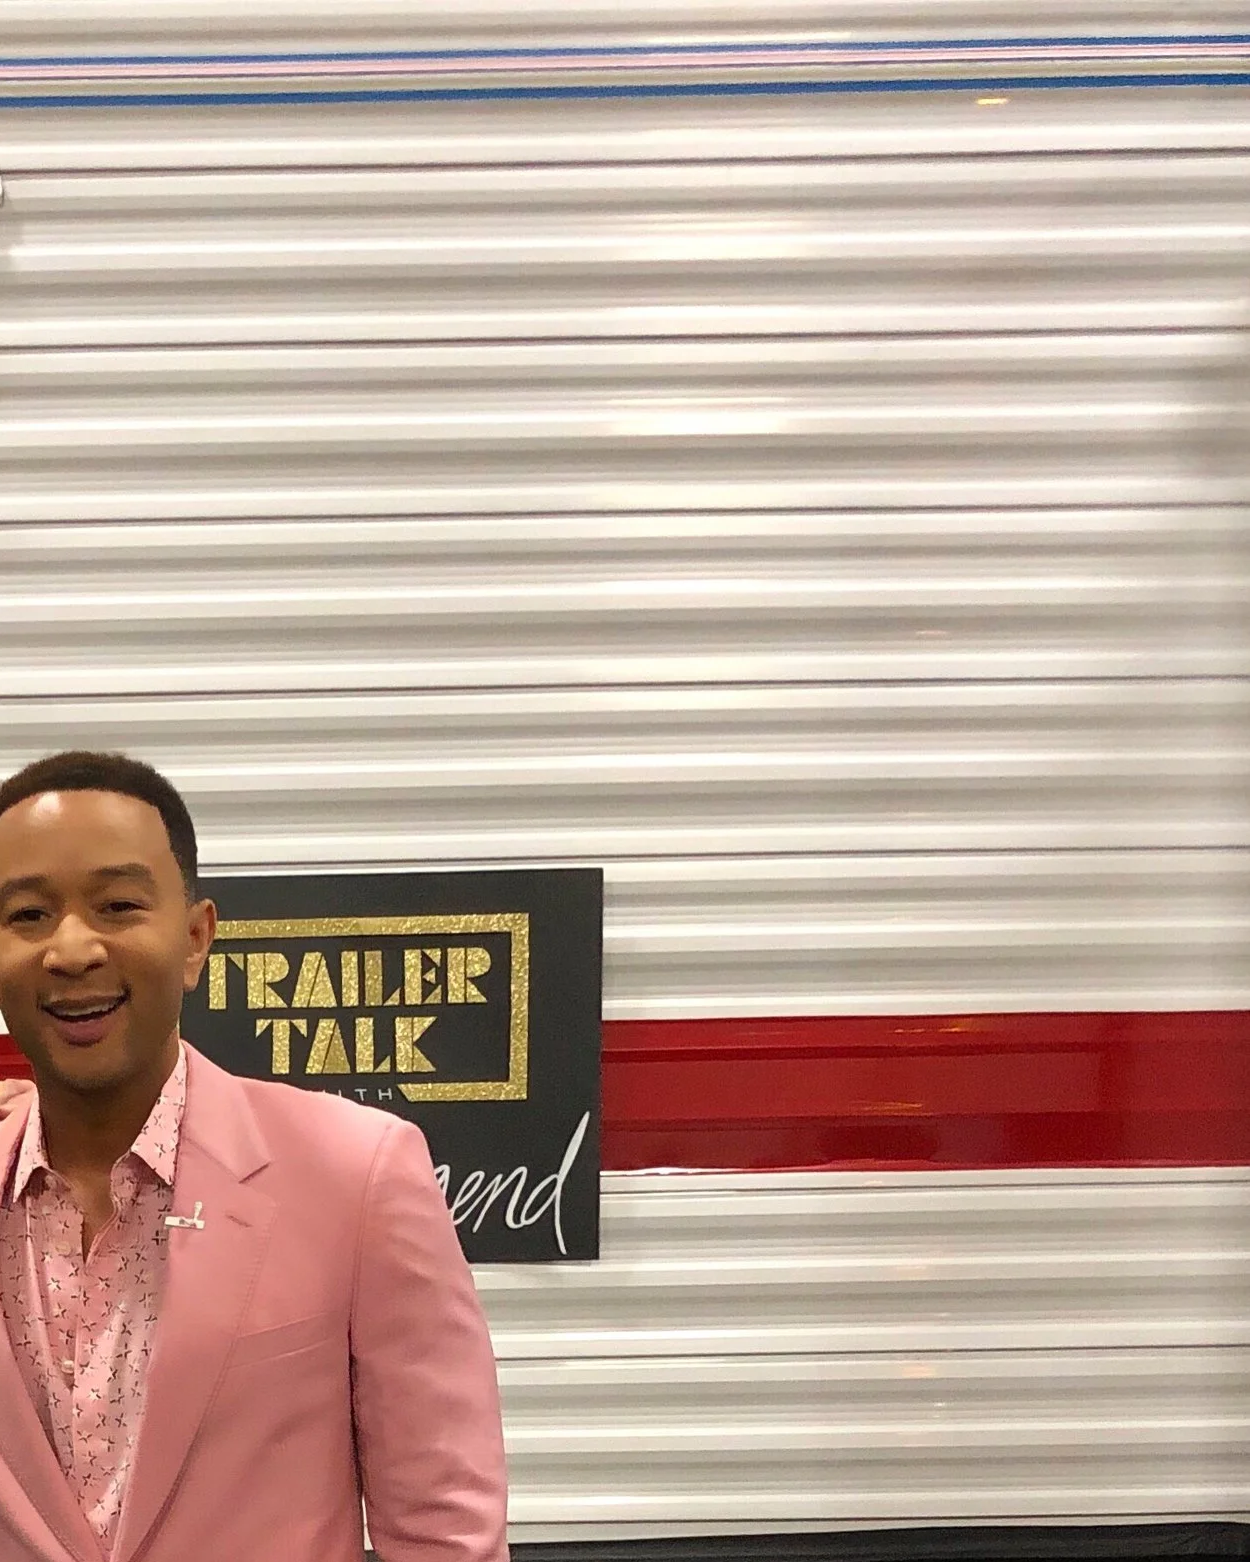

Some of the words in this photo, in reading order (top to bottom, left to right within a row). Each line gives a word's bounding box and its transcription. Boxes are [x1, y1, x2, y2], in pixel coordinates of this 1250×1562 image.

[207, 946, 493, 1010] TRAILER
[255, 1015, 439, 1075] TALK
[322, 1087, 393, 1101] ITH
